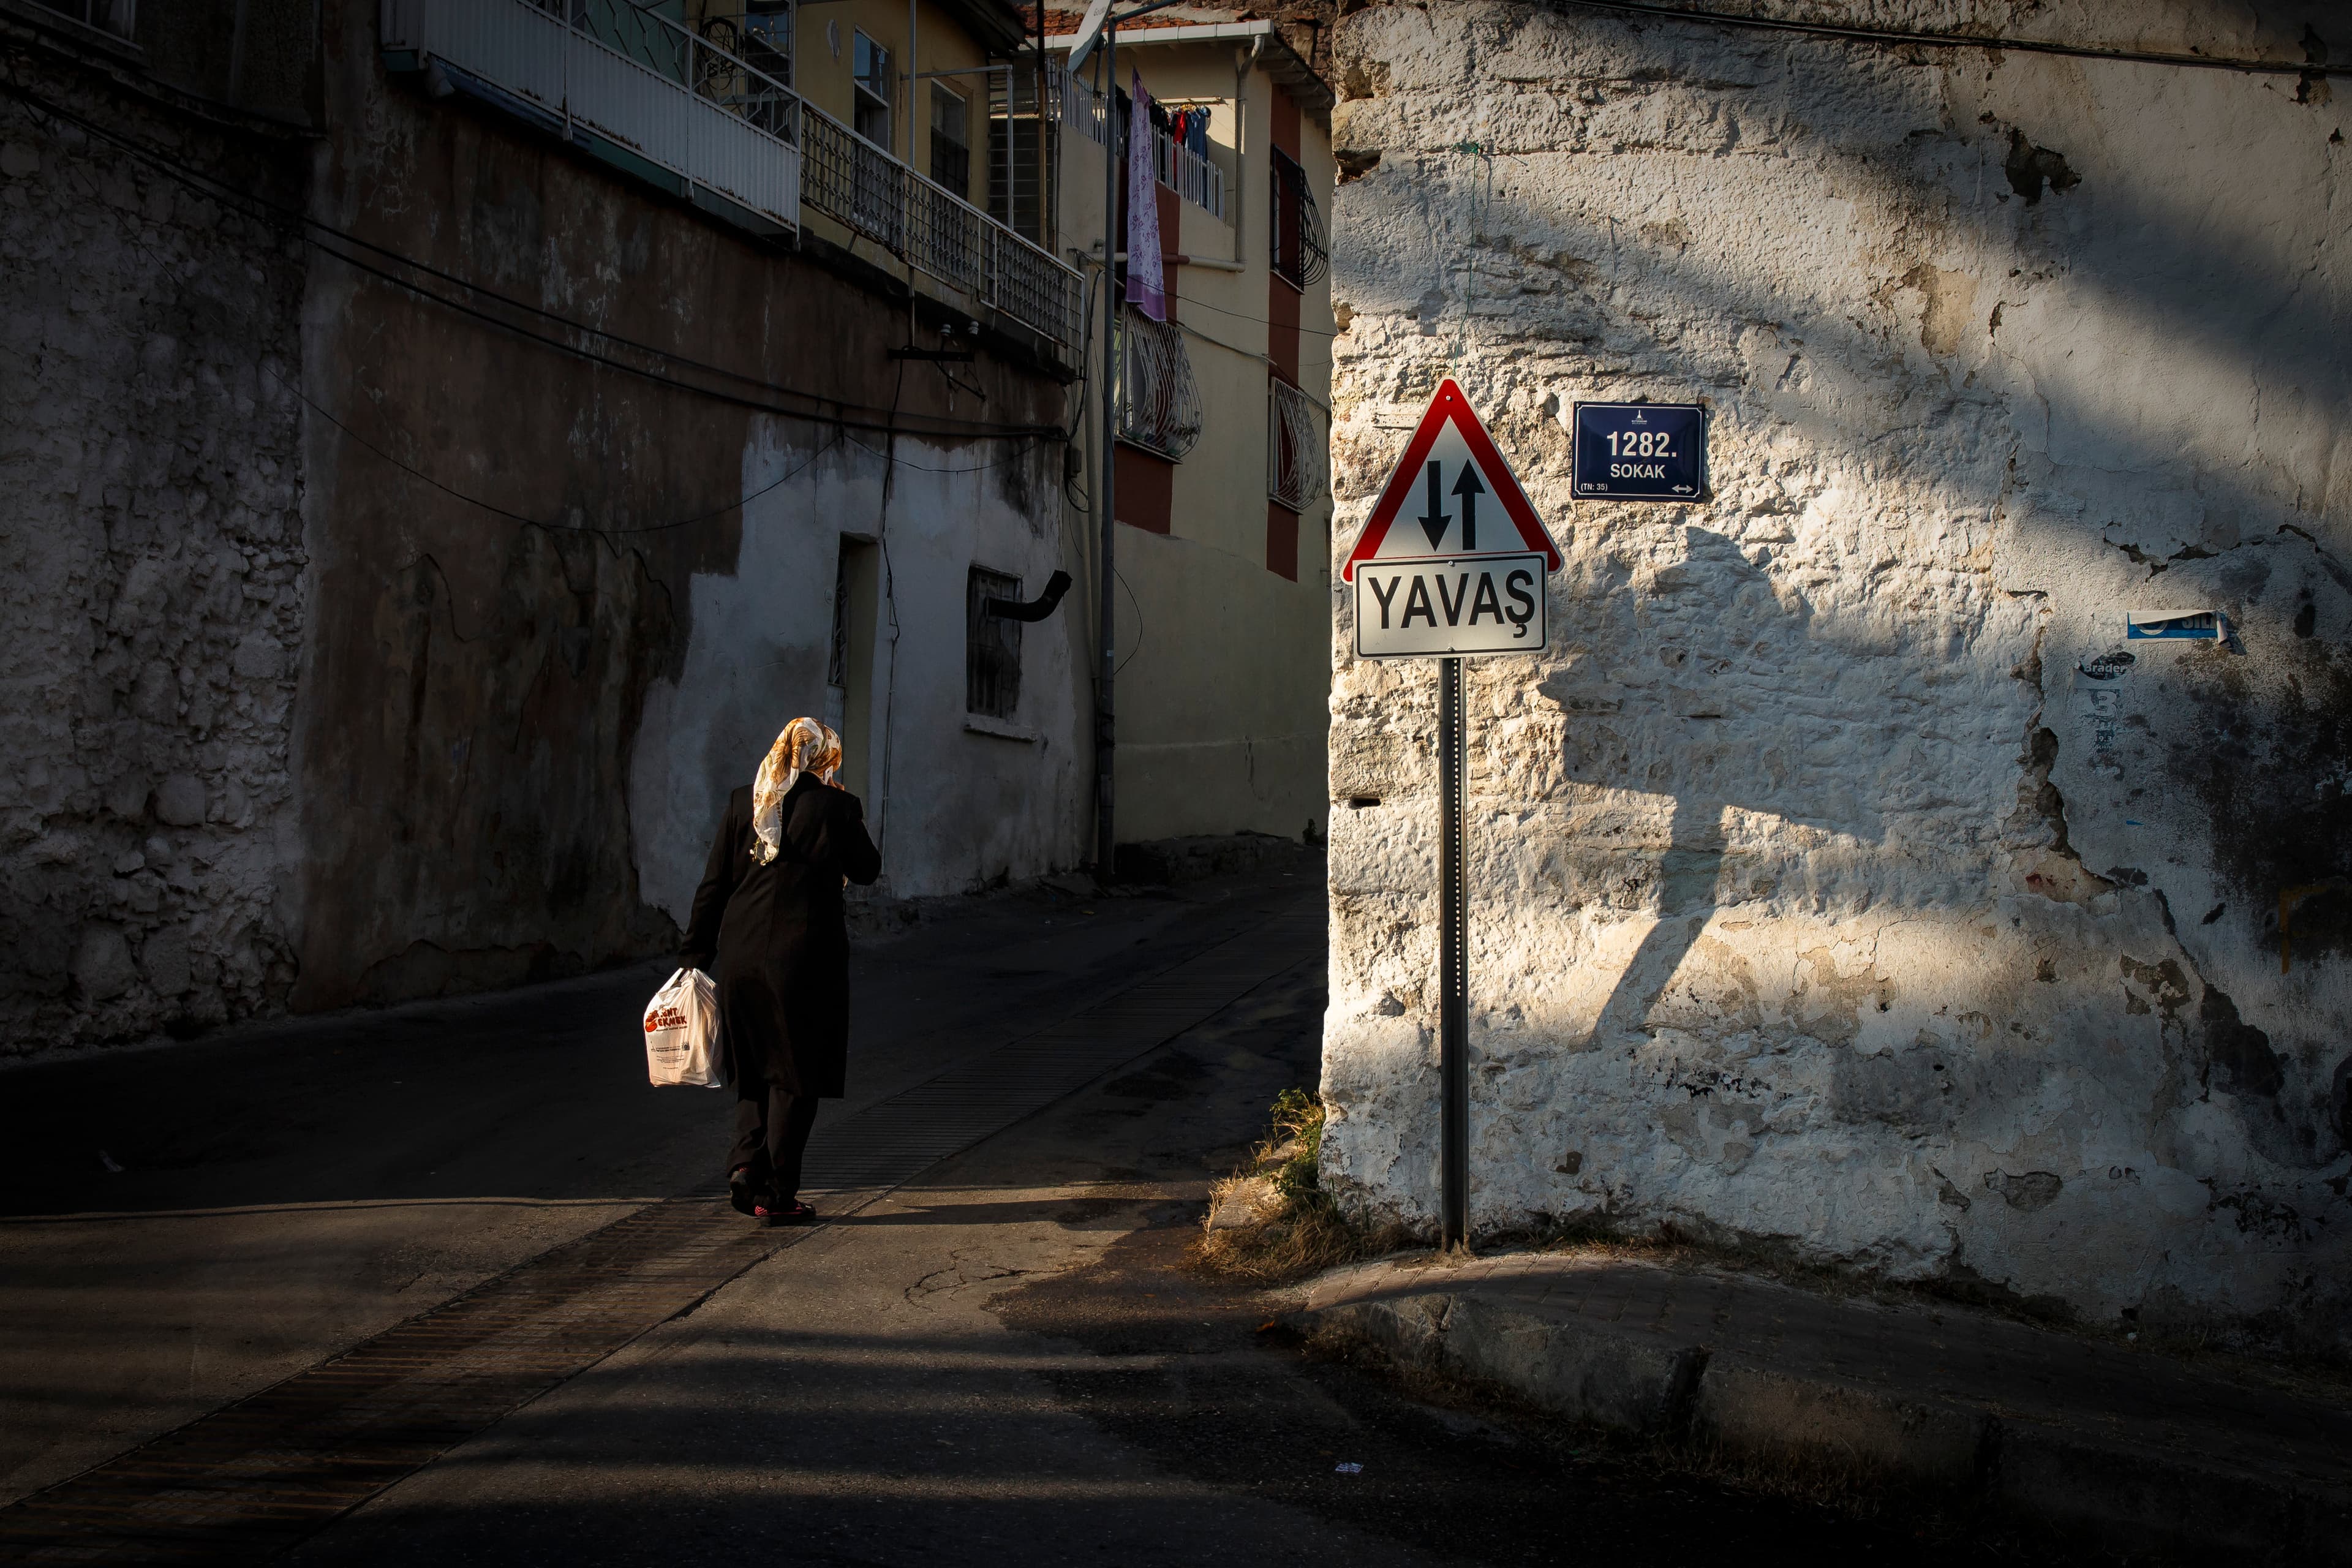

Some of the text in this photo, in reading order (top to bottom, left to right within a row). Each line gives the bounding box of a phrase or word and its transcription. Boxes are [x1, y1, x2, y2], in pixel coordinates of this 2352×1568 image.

[1606, 431, 1677, 458] 1282.
[1610, 464, 1665, 479] SOKAK
[1580, 483, 1608, 492] (TN: 35)
[1368, 569, 1534, 638] YAVAŞ
[658, 1015, 687, 1027] EKMEK
